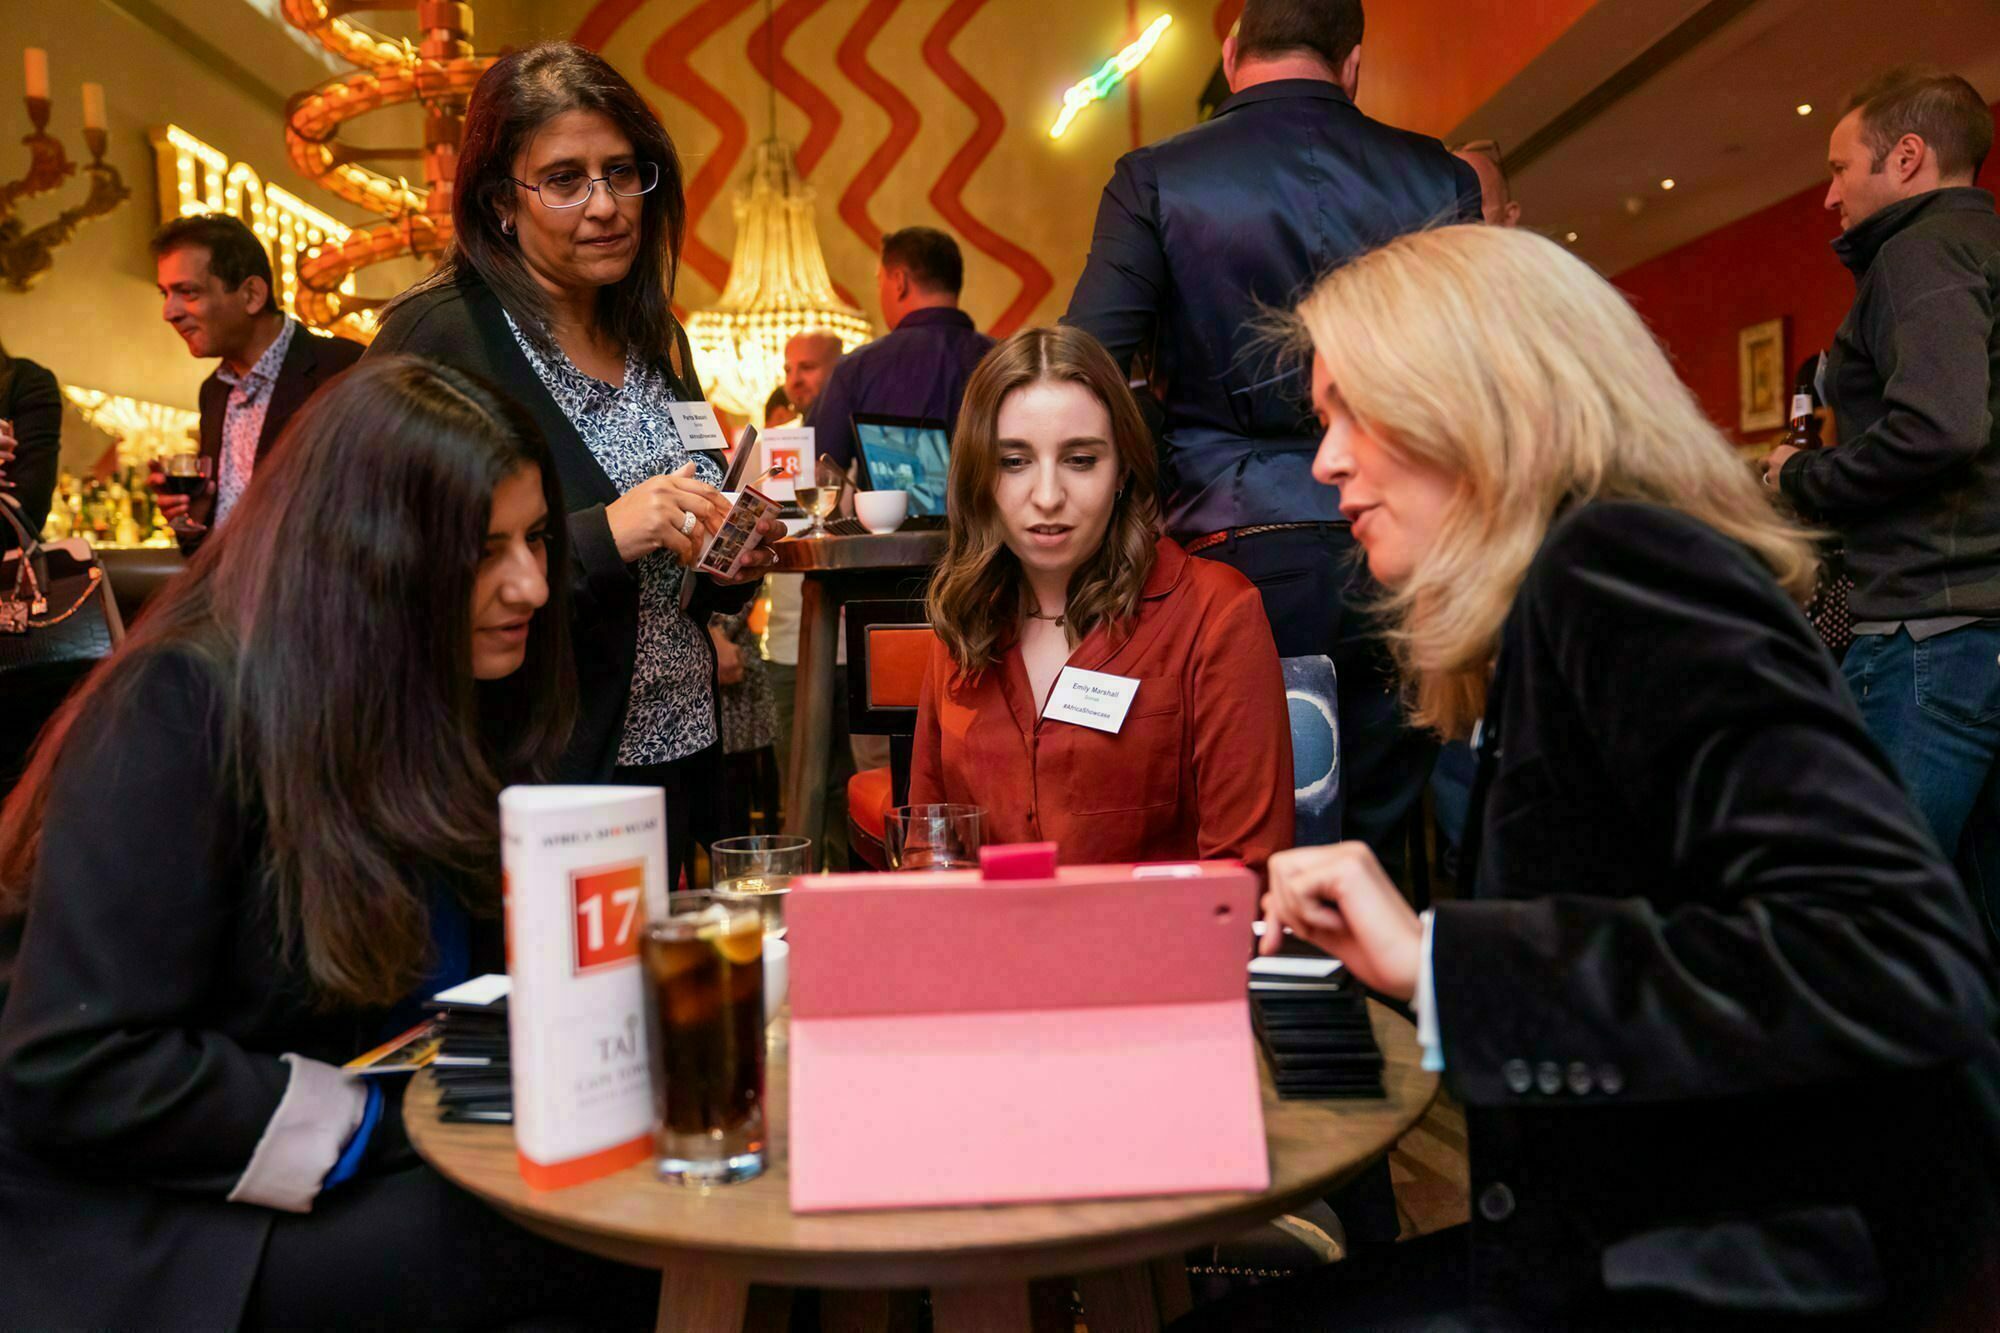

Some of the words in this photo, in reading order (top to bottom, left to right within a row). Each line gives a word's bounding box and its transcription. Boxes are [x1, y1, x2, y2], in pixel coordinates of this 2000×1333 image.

[1072, 682, 1091, 693] Emily
[1091, 686, 1120, 697] Marshall
[1063, 703, 1111, 719] #AfricaShowcase
[578, 886, 641, 951] 17
